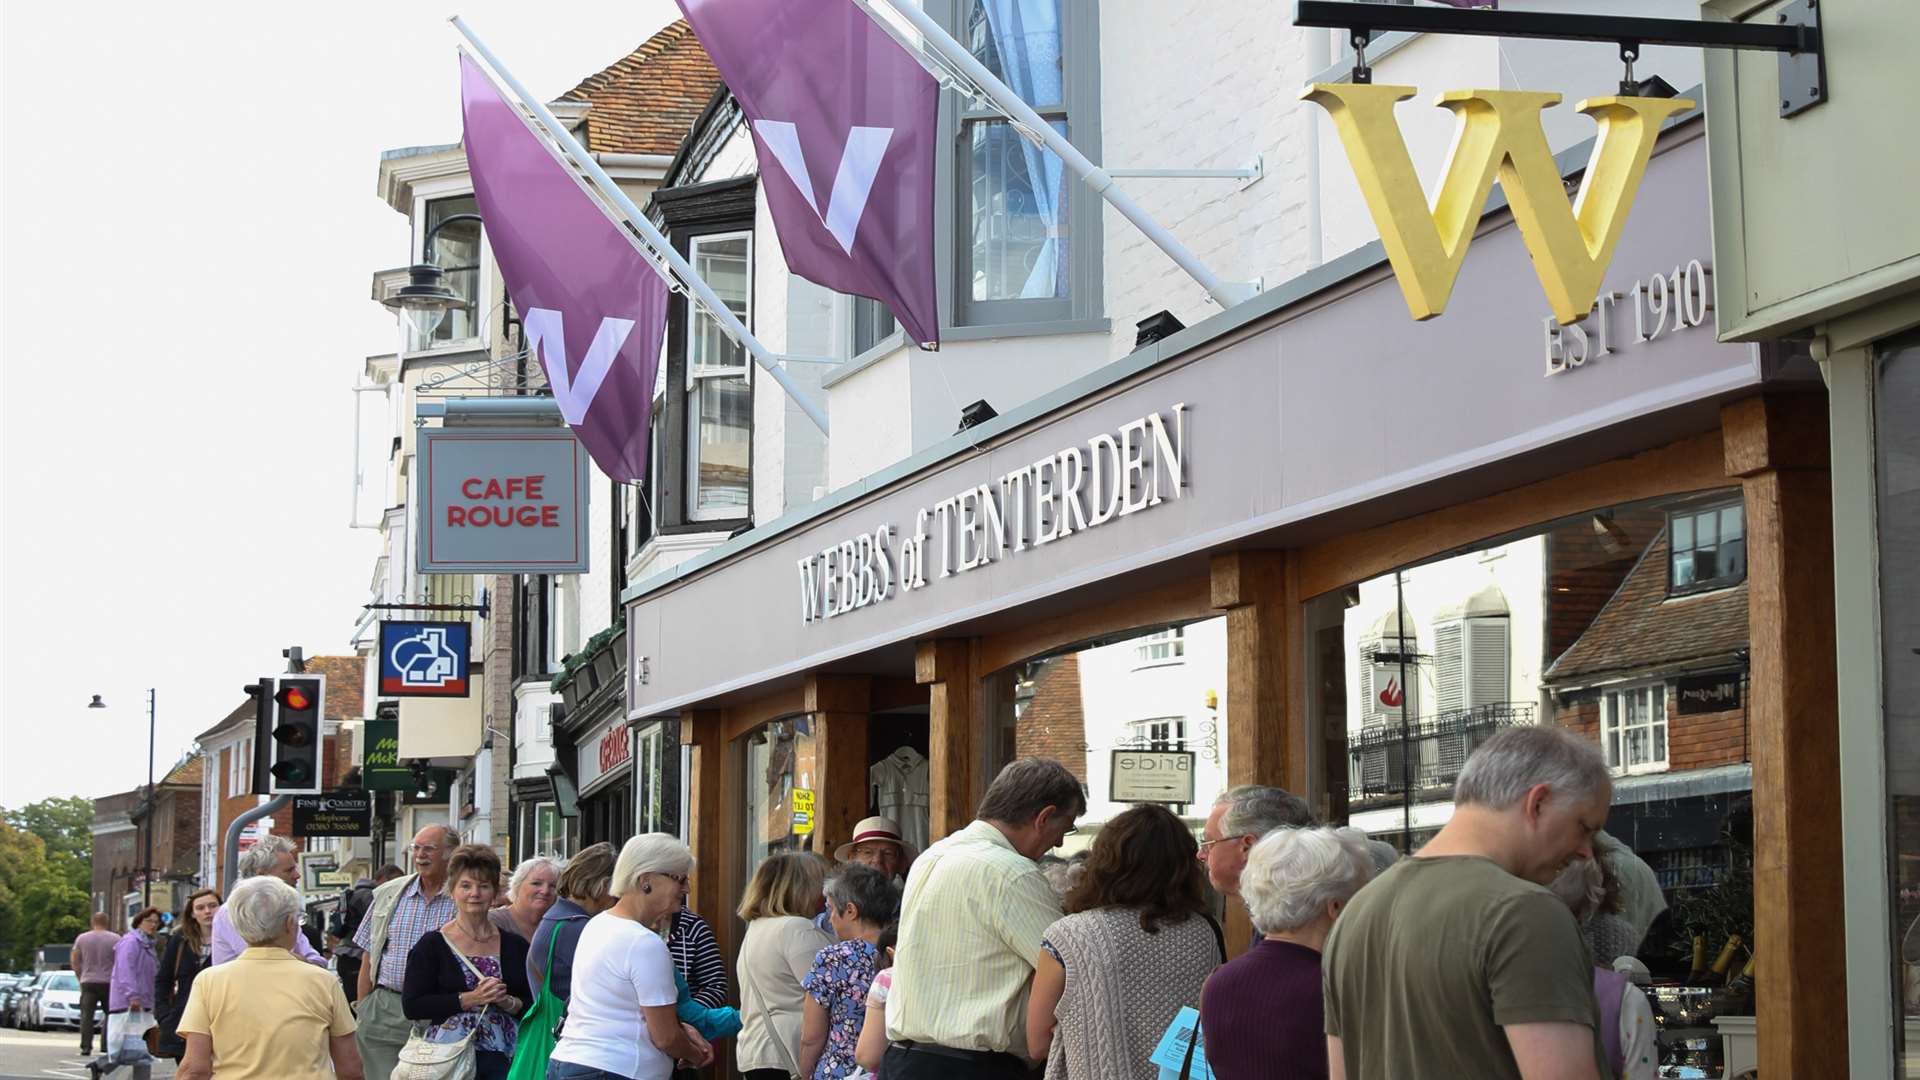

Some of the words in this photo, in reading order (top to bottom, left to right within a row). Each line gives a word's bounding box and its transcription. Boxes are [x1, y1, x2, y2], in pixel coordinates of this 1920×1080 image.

[1300, 82, 1696, 325] W
[1542, 290, 1618, 378] EST
[1630, 259, 1707, 344] 1910
[447, 505, 560, 528] ROUGE
[797, 521, 894, 626] WEBBS
[900, 507, 928, 592] of
[933, 402, 1187, 579] TENTERDEN
